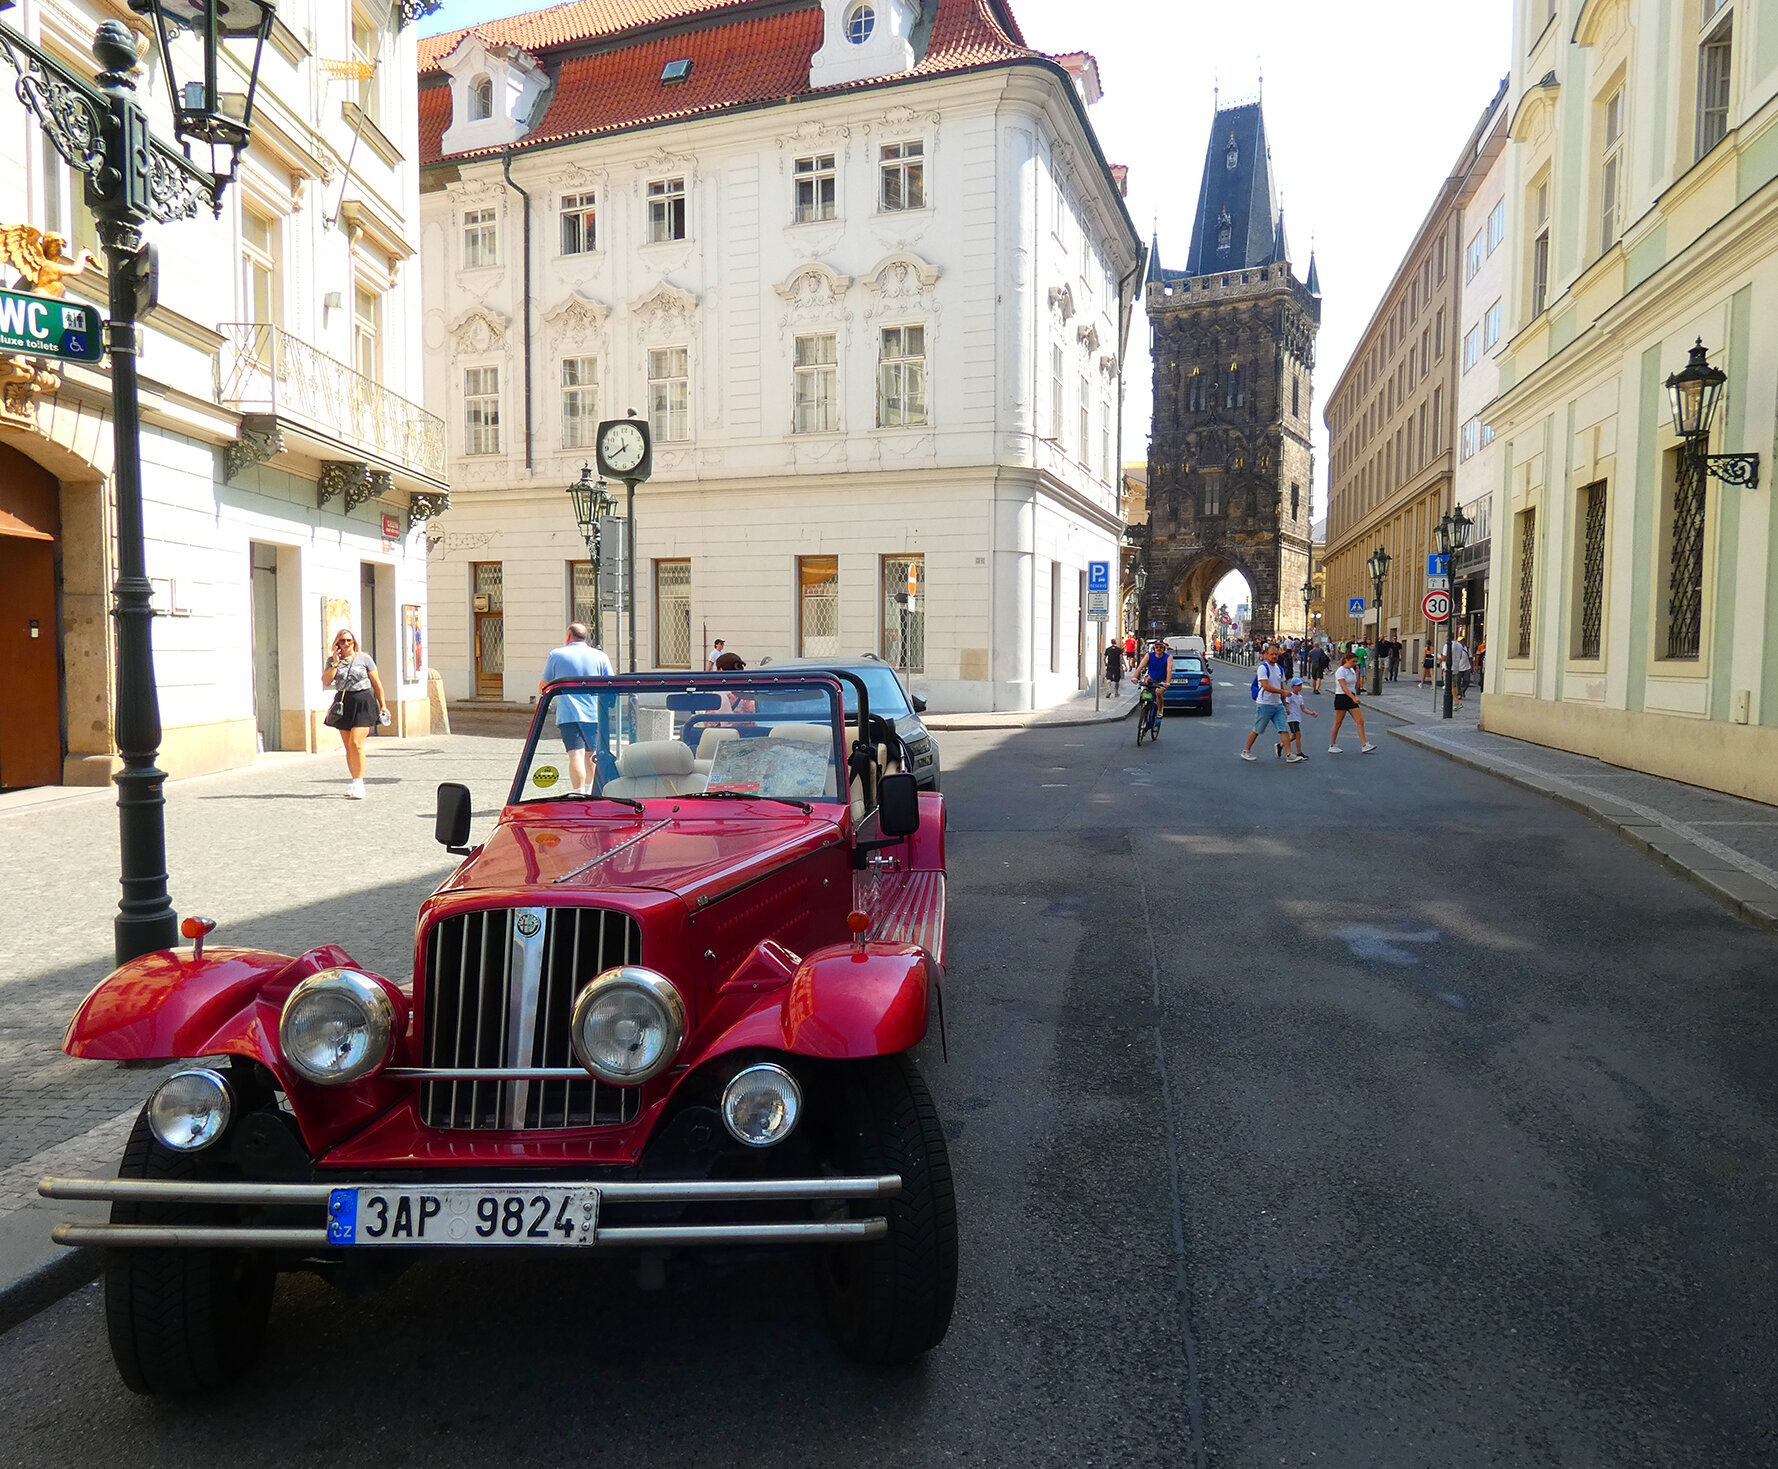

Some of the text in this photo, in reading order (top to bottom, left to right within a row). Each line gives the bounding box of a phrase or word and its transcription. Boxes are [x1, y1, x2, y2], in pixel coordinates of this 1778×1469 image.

[0, 296, 49, 339] WC
[26, 339, 60, 352] toilets
[1092, 564, 1105, 582] P
[1428, 598, 1447, 613] 30
[366, 1195, 575, 1238] 3AP 9824
[334, 1225, 352, 1238] CZ
